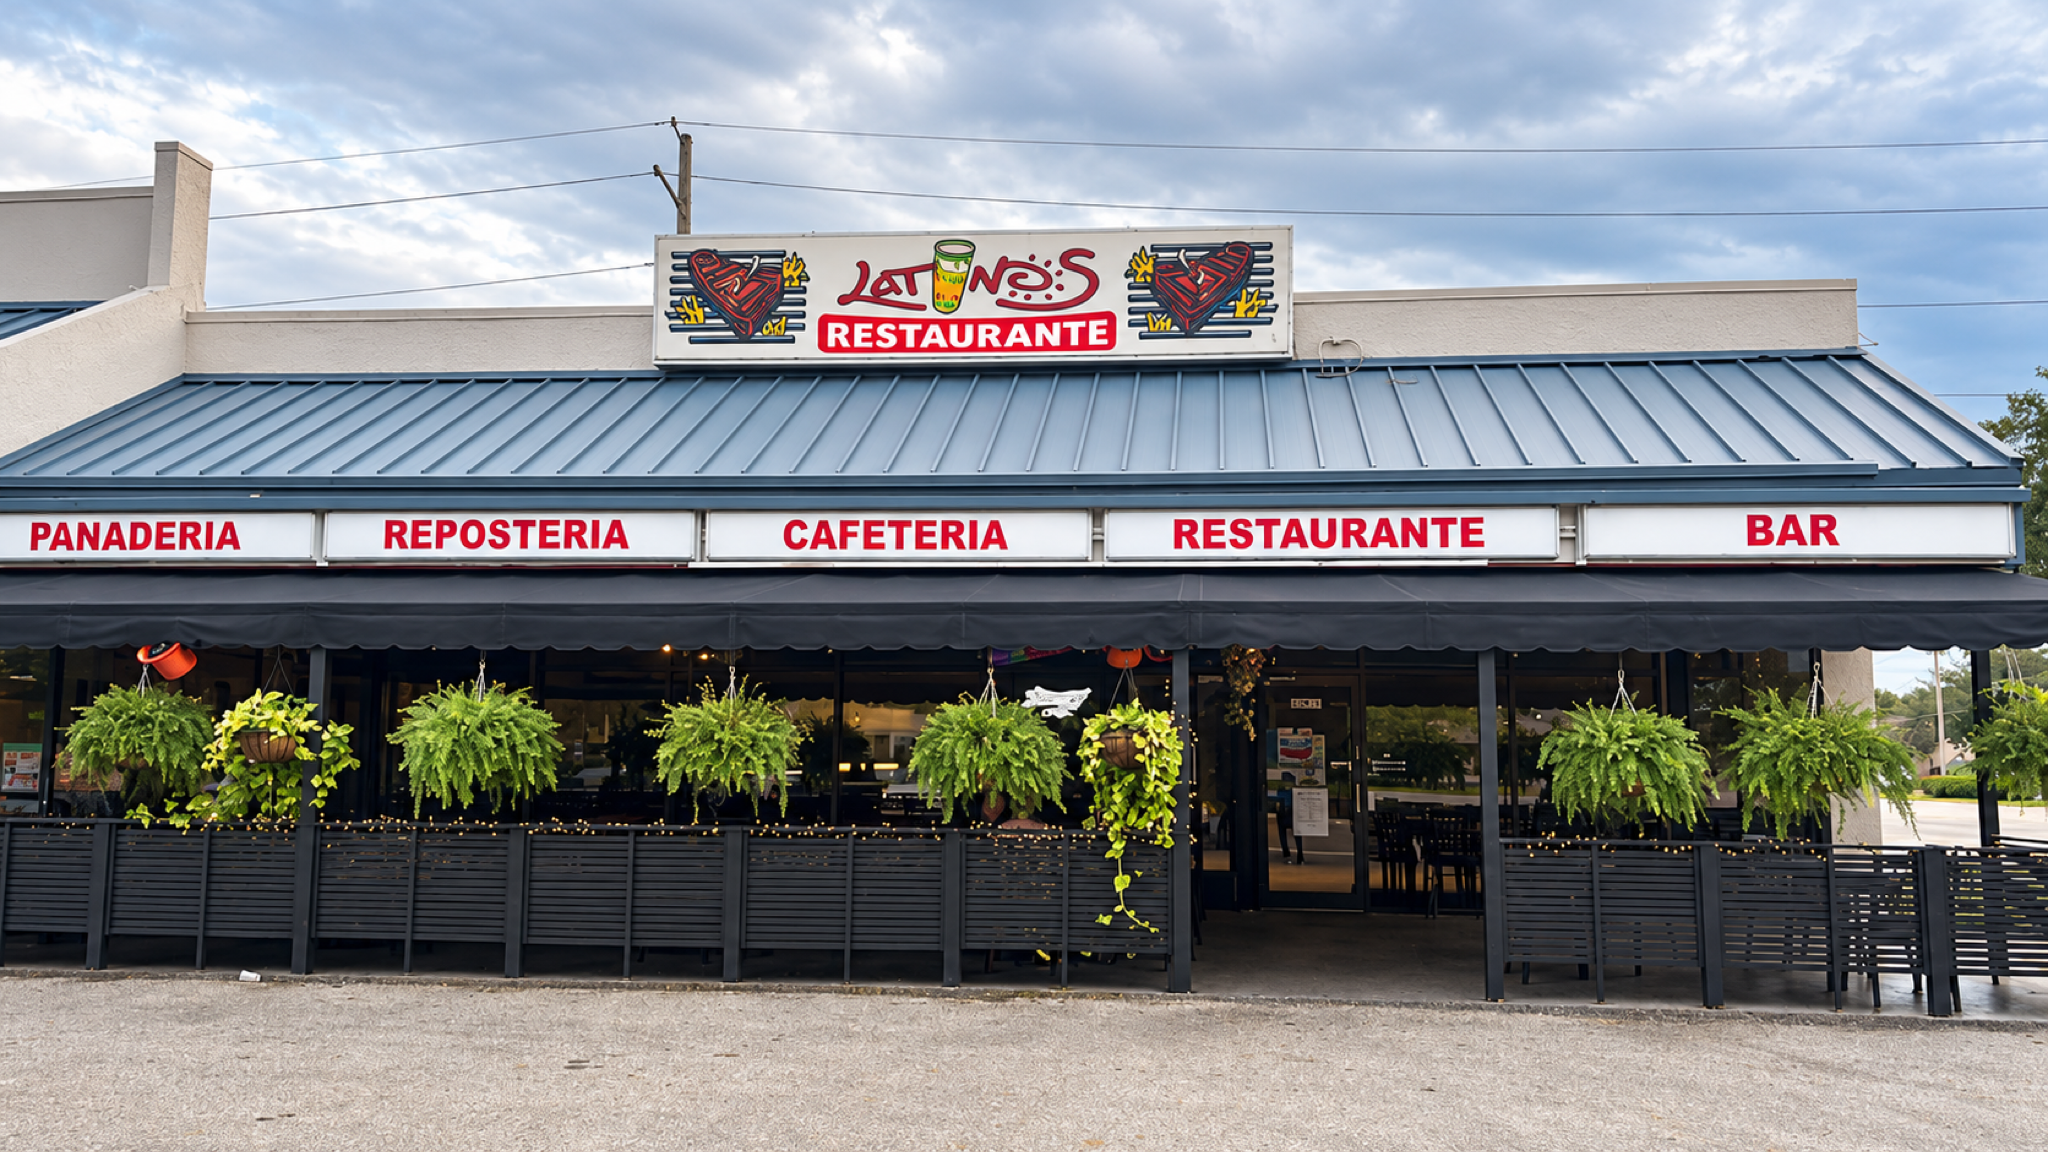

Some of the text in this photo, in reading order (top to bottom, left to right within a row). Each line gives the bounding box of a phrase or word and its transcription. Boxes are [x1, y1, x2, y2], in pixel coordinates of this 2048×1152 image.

[826, 318, 1110, 349] RESTAURANTE
[30, 521, 241, 551] PANADERIA
[384, 519, 629, 550] REPOSTERIA
[783, 519, 1008, 550] CAFETERIA
[1174, 516, 1485, 550] RESTAURANTE
[1746, 514, 1840, 546] BAR
